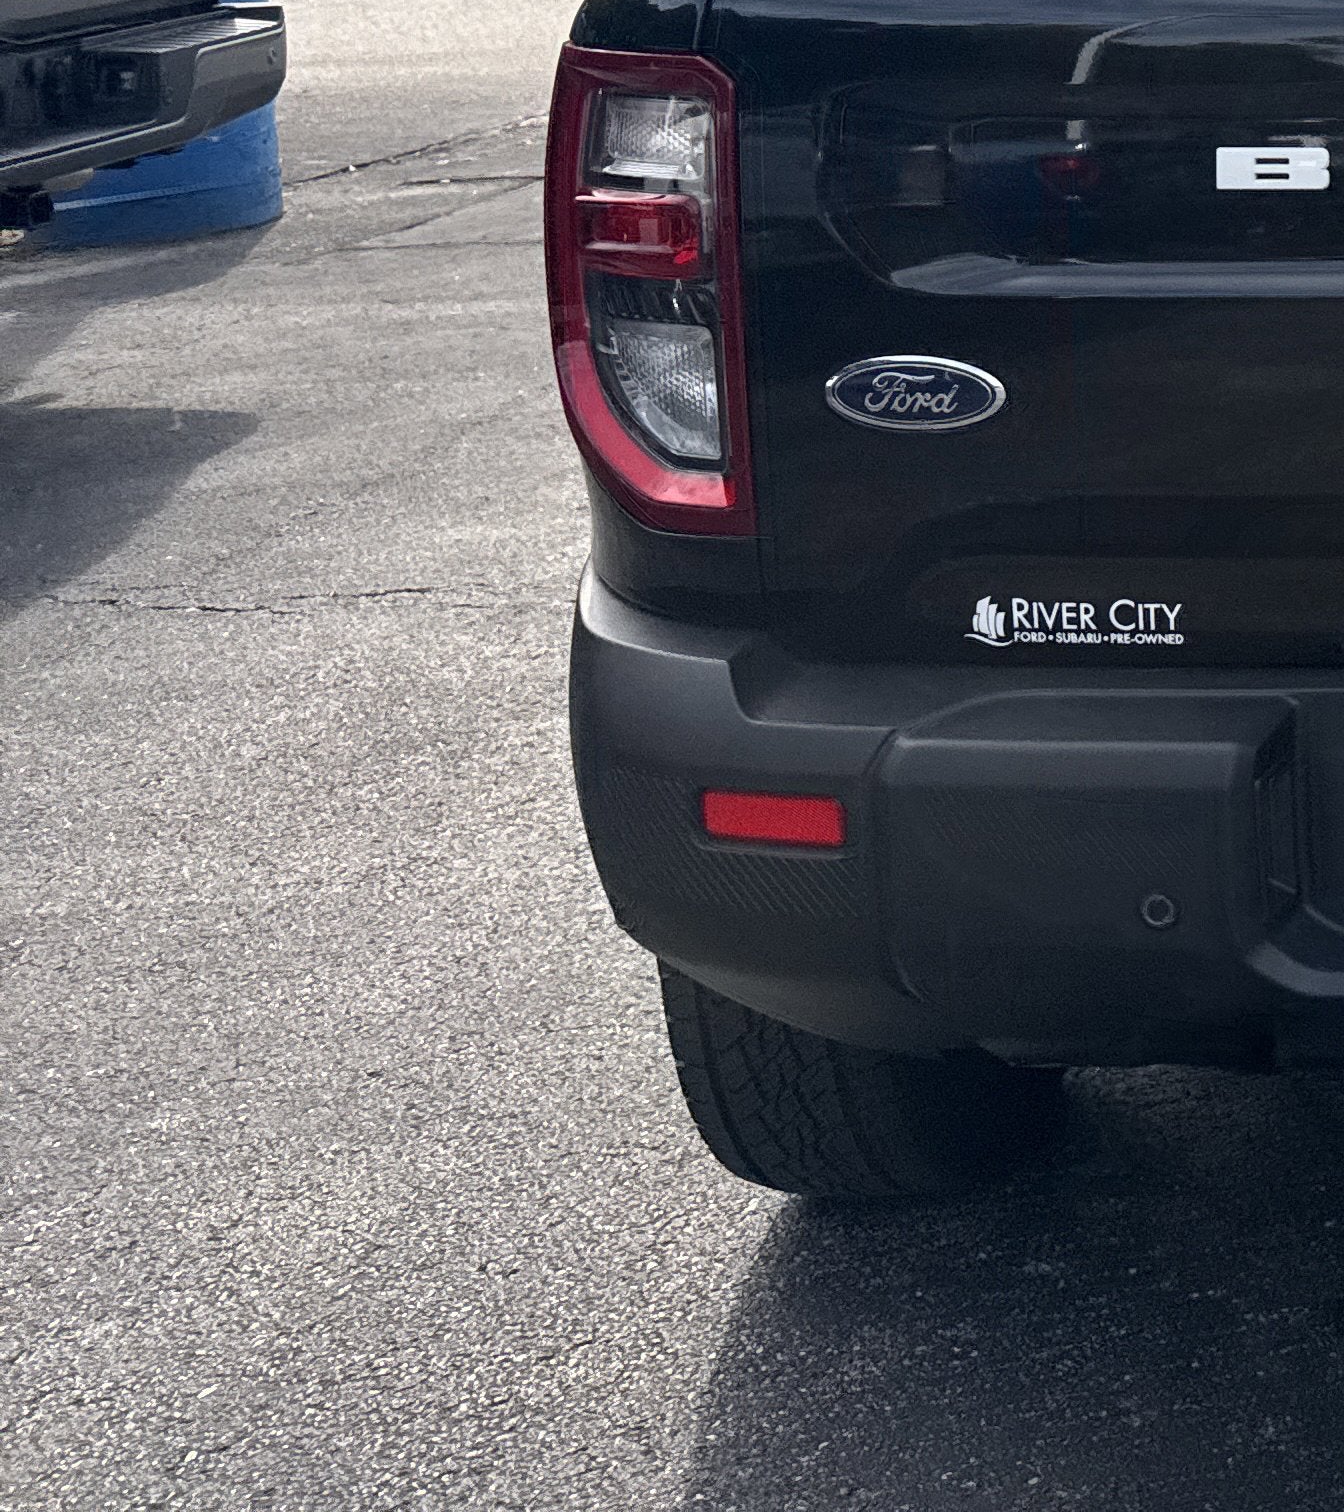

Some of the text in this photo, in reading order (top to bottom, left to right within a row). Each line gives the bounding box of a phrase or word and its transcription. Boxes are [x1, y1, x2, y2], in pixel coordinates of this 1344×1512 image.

[864, 371, 960, 414] Ford
[1013, 631, 1185, 646] FORD SUBARU PRE-OWNED
